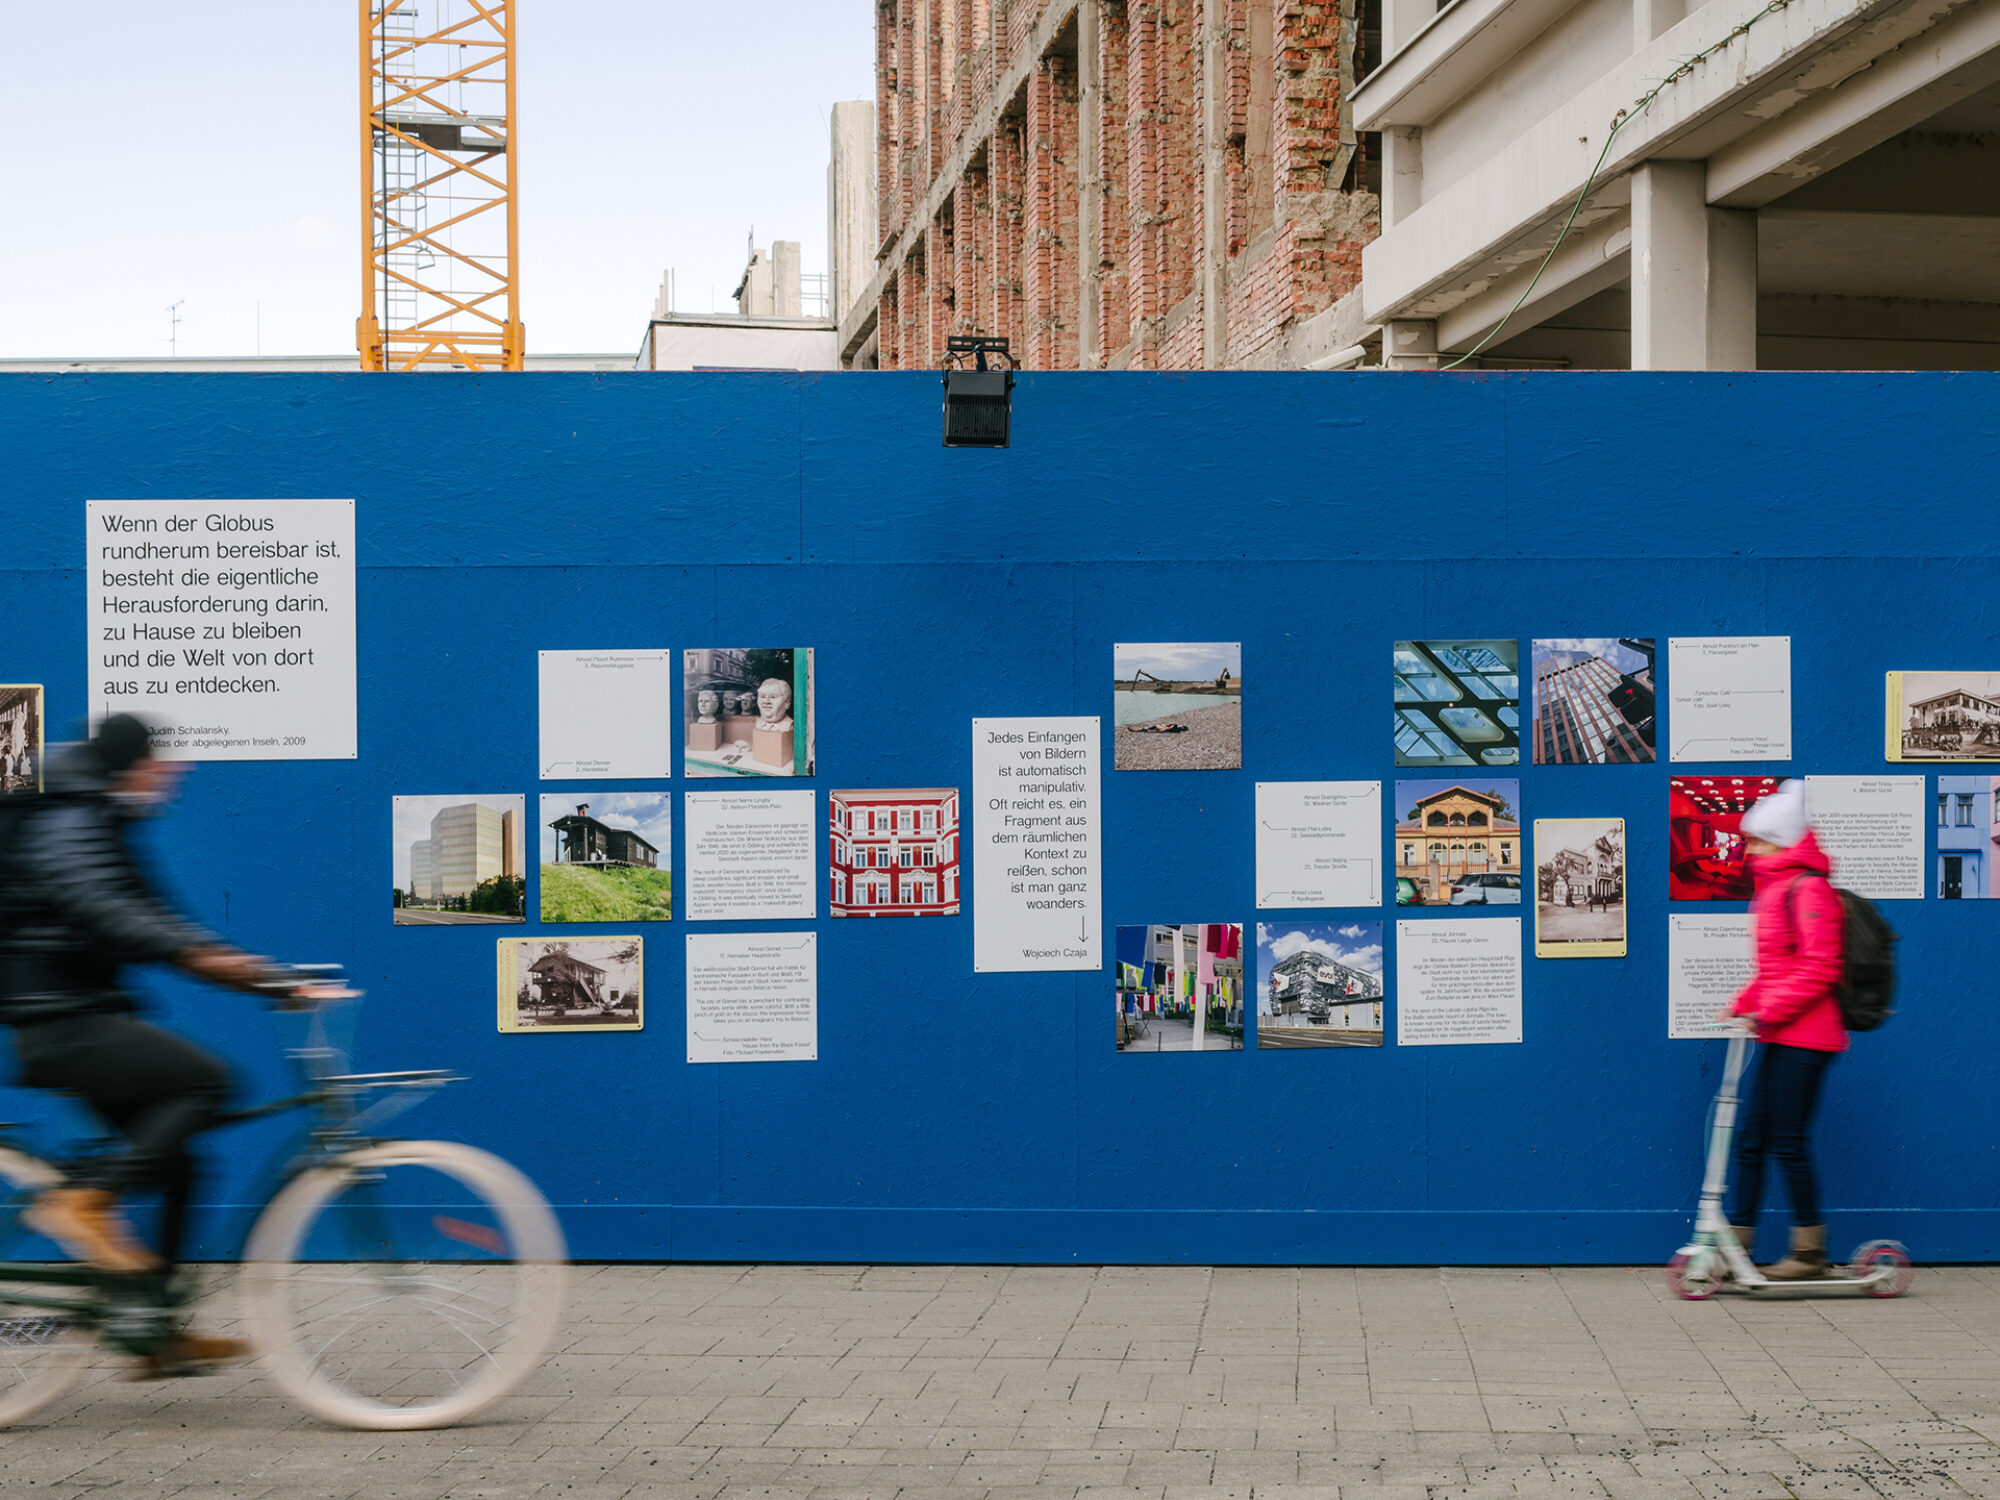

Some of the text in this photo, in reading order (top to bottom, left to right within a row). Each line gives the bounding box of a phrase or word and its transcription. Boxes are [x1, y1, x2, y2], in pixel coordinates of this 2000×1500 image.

[102, 513, 274, 532] Wenn der Globus
[103, 540, 340, 559] rundherum bereisbar ist,
[103, 567, 318, 589] besteht die eigentliche
[103, 594, 328, 616] Herausforderung darin,
[103, 621, 301, 641] zu Hause zu bleiben
[104, 648, 314, 667] und die Welt von dort
[104, 675, 280, 696] aus zu entdecken.
[149, 726, 176, 736] Judith
[986, 730, 1086, 746] Jedes Einfangen
[149, 738, 171, 748] Atlas
[174, 738, 189, 747] der
[192, 738, 250, 748] abgelegenen
[283, 737, 307, 746] 2009
[1018, 746, 1086, 760] von Bildern
[998, 763, 1086, 777] ist automatisch
[1018, 780, 1086, 796] manipulativ.
[988, 796, 1087, 810] Oft reicht es, ein
[1004, 814, 1087, 829] Fragment aus
[991, 828, 1087, 844] dem räumlichen
[1024, 847, 1087, 860] Kontext zu
[1006, 861, 1087, 878] reißen, schon
[1010, 881, 1087, 895] ist man ganz
[1025, 896, 1087, 910] woanders.
[1022, 947, 1088, 959] Wojciech Czaja
